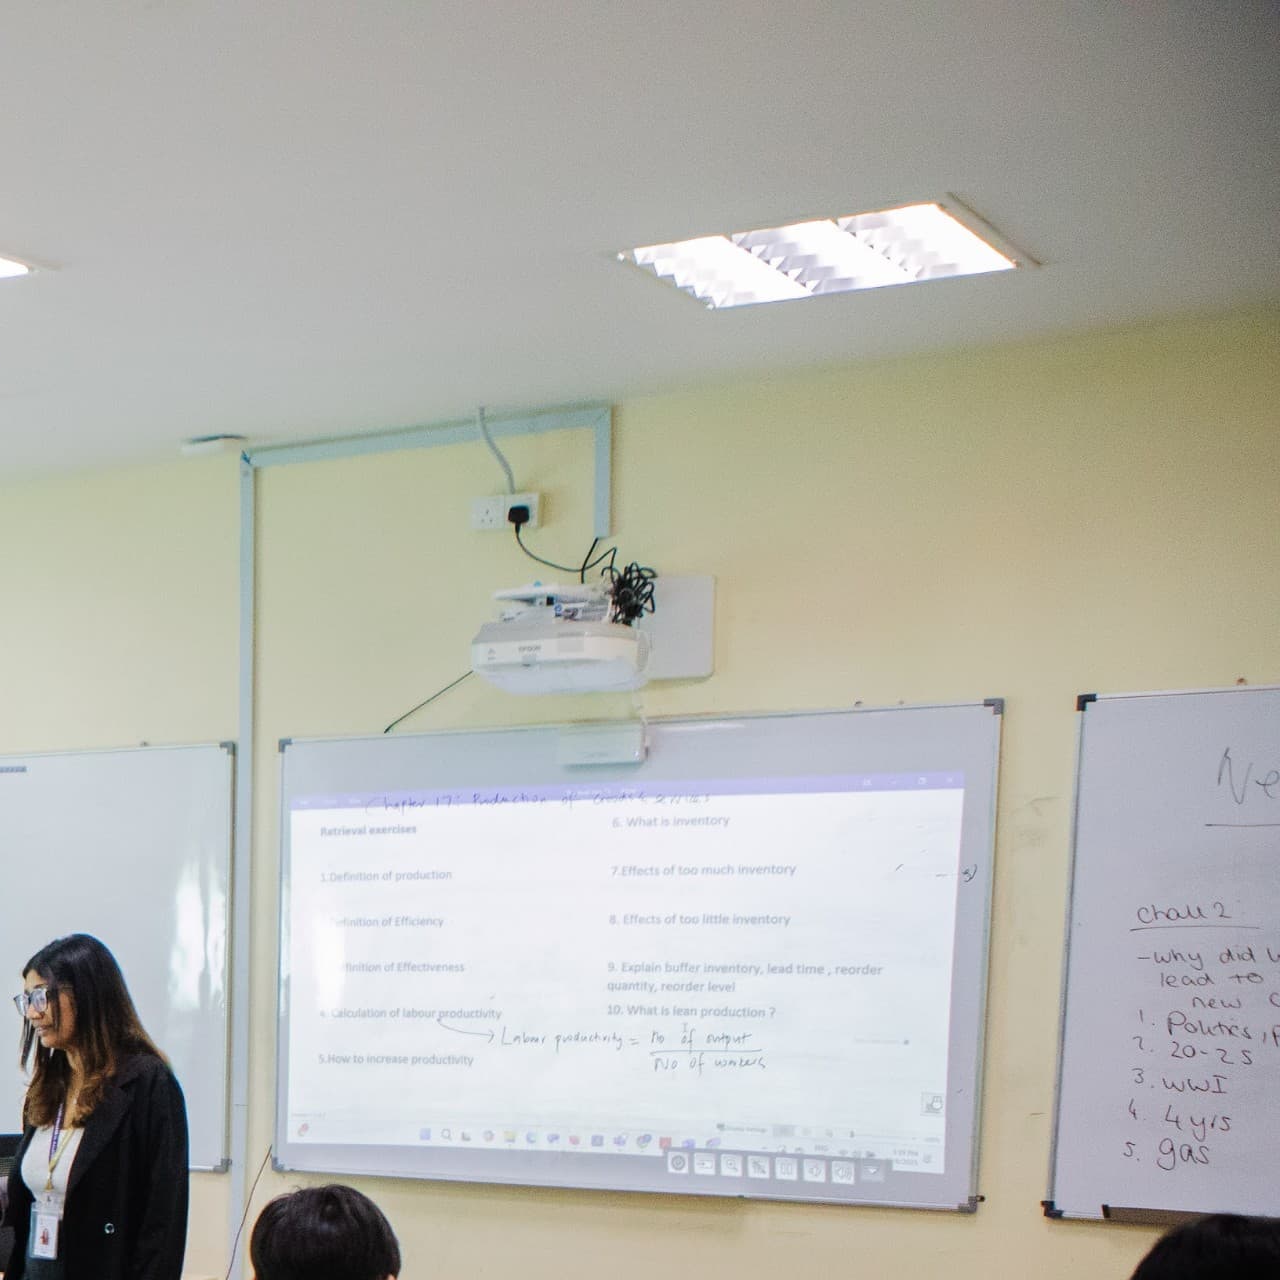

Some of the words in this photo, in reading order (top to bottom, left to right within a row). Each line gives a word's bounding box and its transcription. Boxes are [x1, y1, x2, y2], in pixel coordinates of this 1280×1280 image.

[626, 816, 658, 828] What
[660, 815, 670, 827] is
[673, 815, 730, 828] inventory
[320, 825, 367, 837] Retrieval
[369, 824, 417, 835] exercises
[382, 870, 393, 881] of
[395, 870, 452, 883] production
[663, 865, 676, 876] of
[678, 865, 698, 876] too
[701, 864, 735, 876] much
[738, 863, 797, 877] inventory
[1213, 901, 1233, 919] 2
[382, 916, 392, 927] of
[395, 916, 444, 929] Efficiency
[623, 914, 662, 926] Effects
[664, 914, 677, 925] of
[680, 914, 700, 925] too
[702, 913, 729, 925] little
[732, 913, 791, 928] inventory
[1219, 947, 1256, 964] did
[384, 962, 395, 973] of
[397, 961, 465, 973] Effectiveness
[621, 962, 662, 975] Explain
[665, 962, 700, 974] buffer
[703, 963, 764, 977] inventory,
[767, 963, 793, 975] lead
[796, 963, 825, 975] time
[835, 964, 883, 976] reorder
[607, 981, 658, 993] quantity,
[661, 981, 704, 992] reorder
[707, 981, 736, 993] level
[1160, 972, 1215, 988] lead
[1228, 972, 1264, 985] to
[1192, 996, 1242, 1009] new
[389, 1007, 400, 1019] of
[402, 1007, 436, 1019] labour
[438, 1008, 502, 1021] productivity
[627, 1004, 658, 1017] What
[661, 1005, 670, 1017] is
[672, 1005, 697, 1018] lean
[700, 1006, 766, 1019] production
[352, 1054, 364, 1066] to
[366, 1054, 409, 1066] increase
[411, 1054, 474, 1067] productivity
[1156, 1137, 1209, 1170] gas
